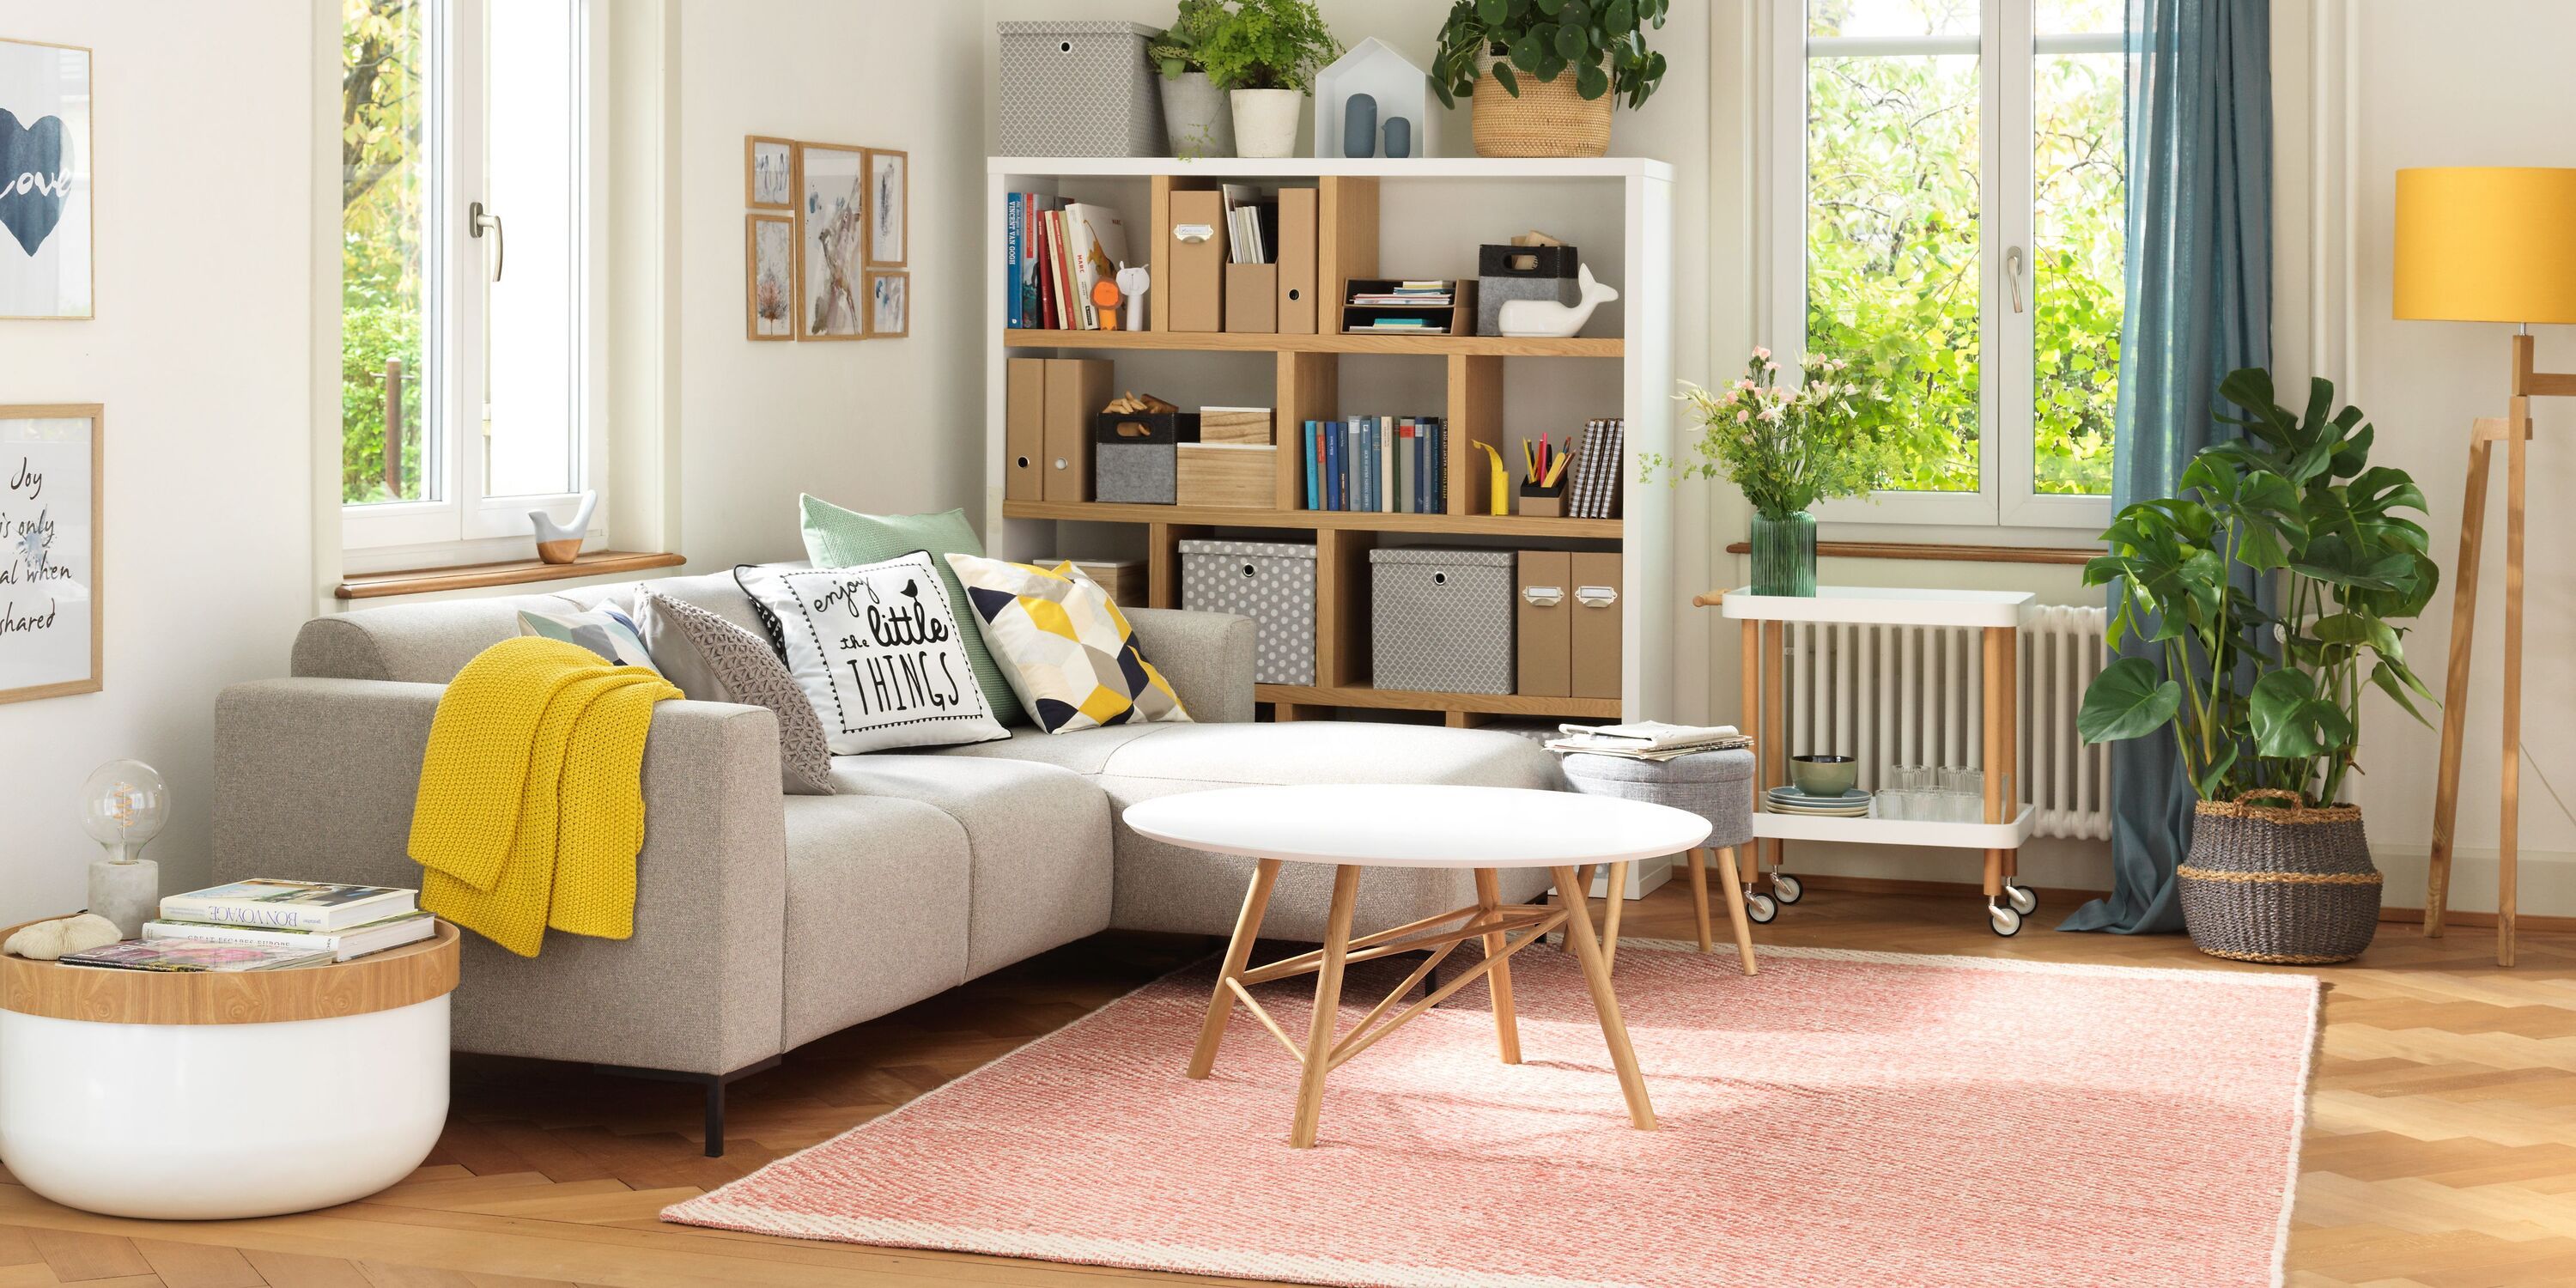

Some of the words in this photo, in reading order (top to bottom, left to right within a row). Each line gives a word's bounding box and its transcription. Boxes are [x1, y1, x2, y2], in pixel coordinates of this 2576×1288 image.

[10, 457, 42, 500] Joy
[0, 512, 9, 539] is
[18, 509, 55, 547] only
[0, 559, 18, 585] al
[27, 550, 72, 583] when
[813, 576, 880, 617] enjoy
[0, 598, 56, 636] shared
[840, 635, 870, 650] the
[867, 601, 949, 647] little
[847, 650, 959, 715] THINGS
[208, 905, 264, 925] VOYAGE
[266, 911, 298, 927] BON
